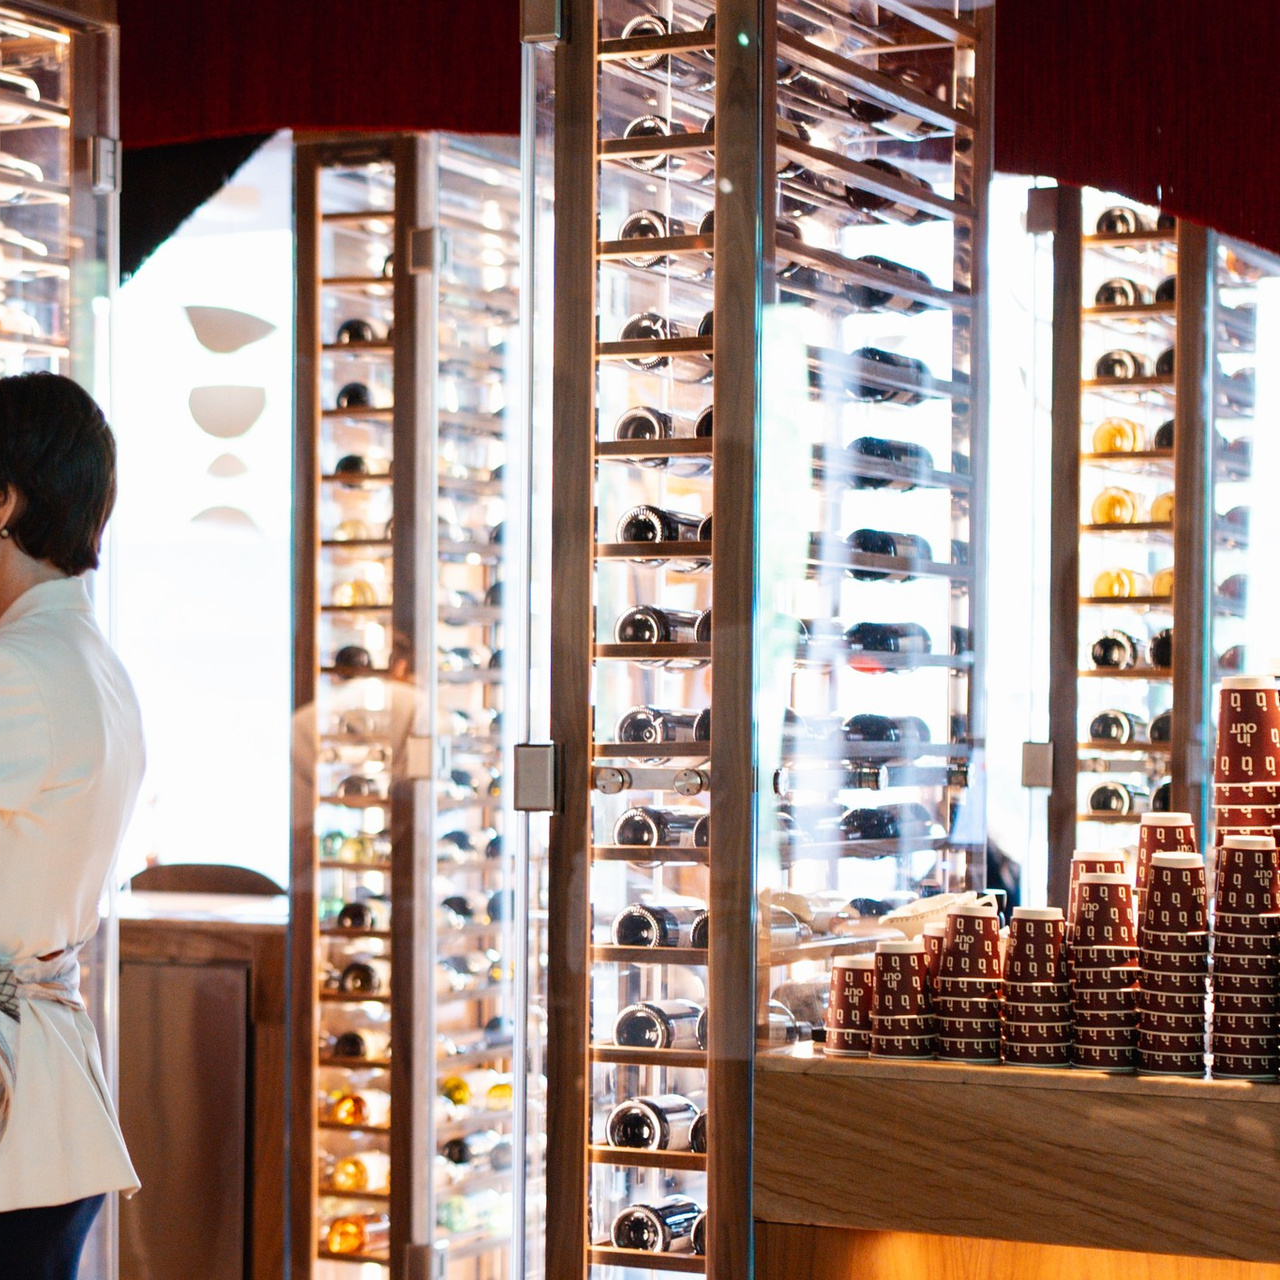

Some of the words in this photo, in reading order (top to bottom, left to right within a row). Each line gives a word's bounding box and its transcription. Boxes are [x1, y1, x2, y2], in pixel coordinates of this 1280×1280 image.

[1230, 723, 1257, 733] OUT
[1237, 734, 1251, 747] in
[1254, 870, 1272, 878] OUT
[1260, 878, 1270, 888] in
[1081, 903, 1099, 911] OUT
[1085, 911, 1094, 921] in
[954, 935, 974, 943] OUT
[959, 943, 969, 953] in
[887, 980, 897, 990] in
[844, 988, 864, 996] OUT
[849, 996, 859, 1005] in
